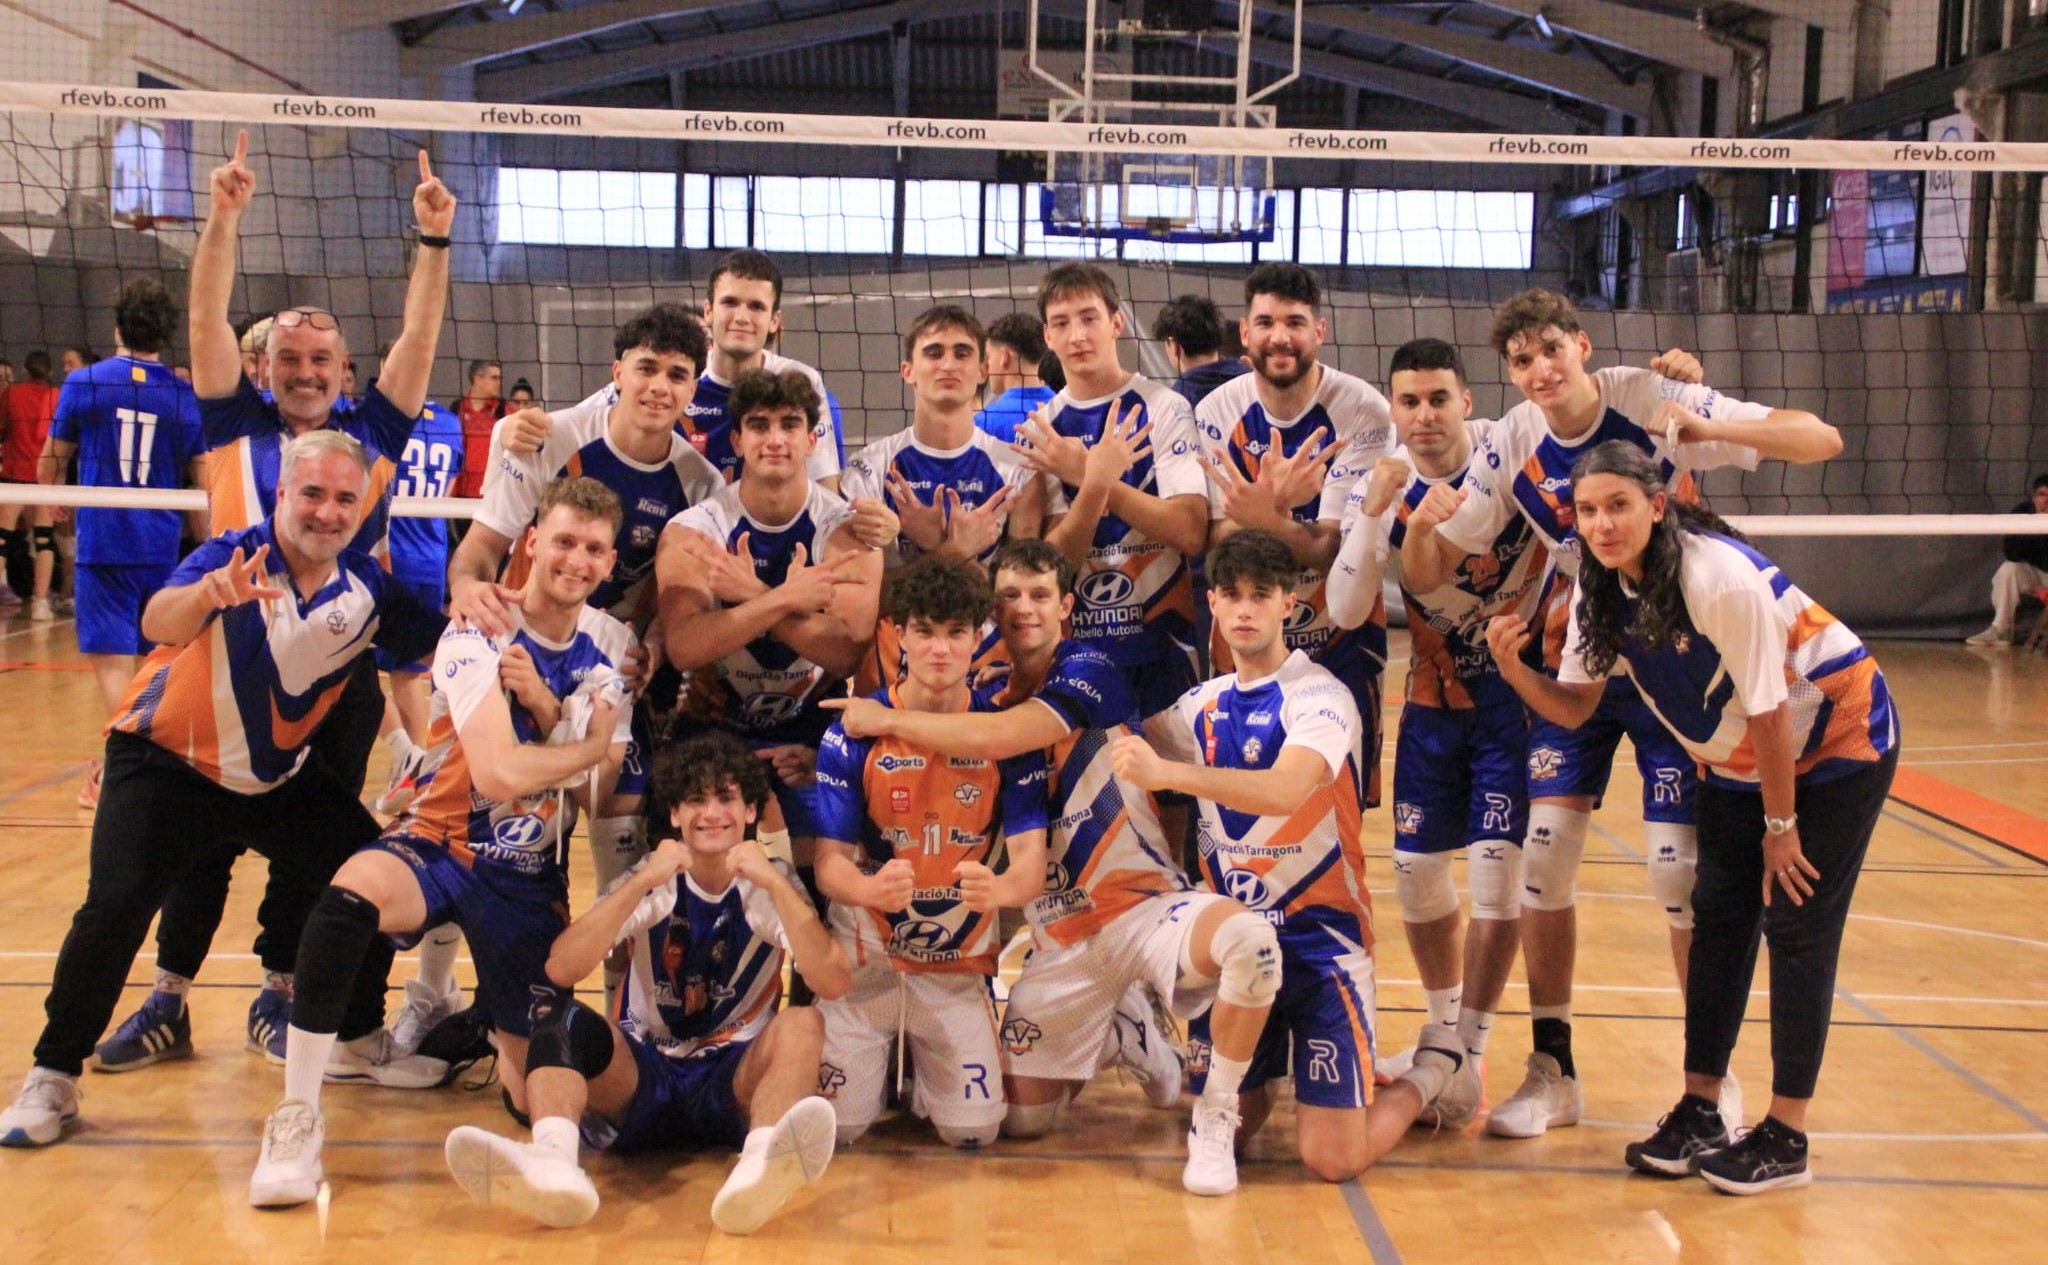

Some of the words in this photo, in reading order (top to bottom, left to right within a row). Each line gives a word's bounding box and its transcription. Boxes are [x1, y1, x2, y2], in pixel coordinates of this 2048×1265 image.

[61, 88, 167, 110] rfevb.com
[273, 97, 376, 118] rfevb.com
[481, 105, 583, 127] rfevb.com
[685, 113, 786, 134] rfevb.com
[887, 120, 987, 140] rfevb.com
[1088, 126, 1187, 146] rfevb.com
[1289, 131, 1388, 151] rfevb.com
[1489, 137, 1589, 157] rfevb.com
[1690, 139, 1791, 160] rfevb.com
[1894, 144, 1995, 162] rfevb.com
[116, 407, 157, 485] 11
[397, 438, 452, 498] 33
[1072, 605, 1142, 626] HYUNDAI
[1285, 629, 1328, 646] NDAI
[1068, 677, 1102, 703] EOLIA
[1319, 708, 1348, 733] EOLIA
[923, 823, 941, 856] 11
[1244, 844, 1302, 860] Tarragona
[1307, 1039, 1340, 1083] R
[963, 1063, 991, 1100] R
